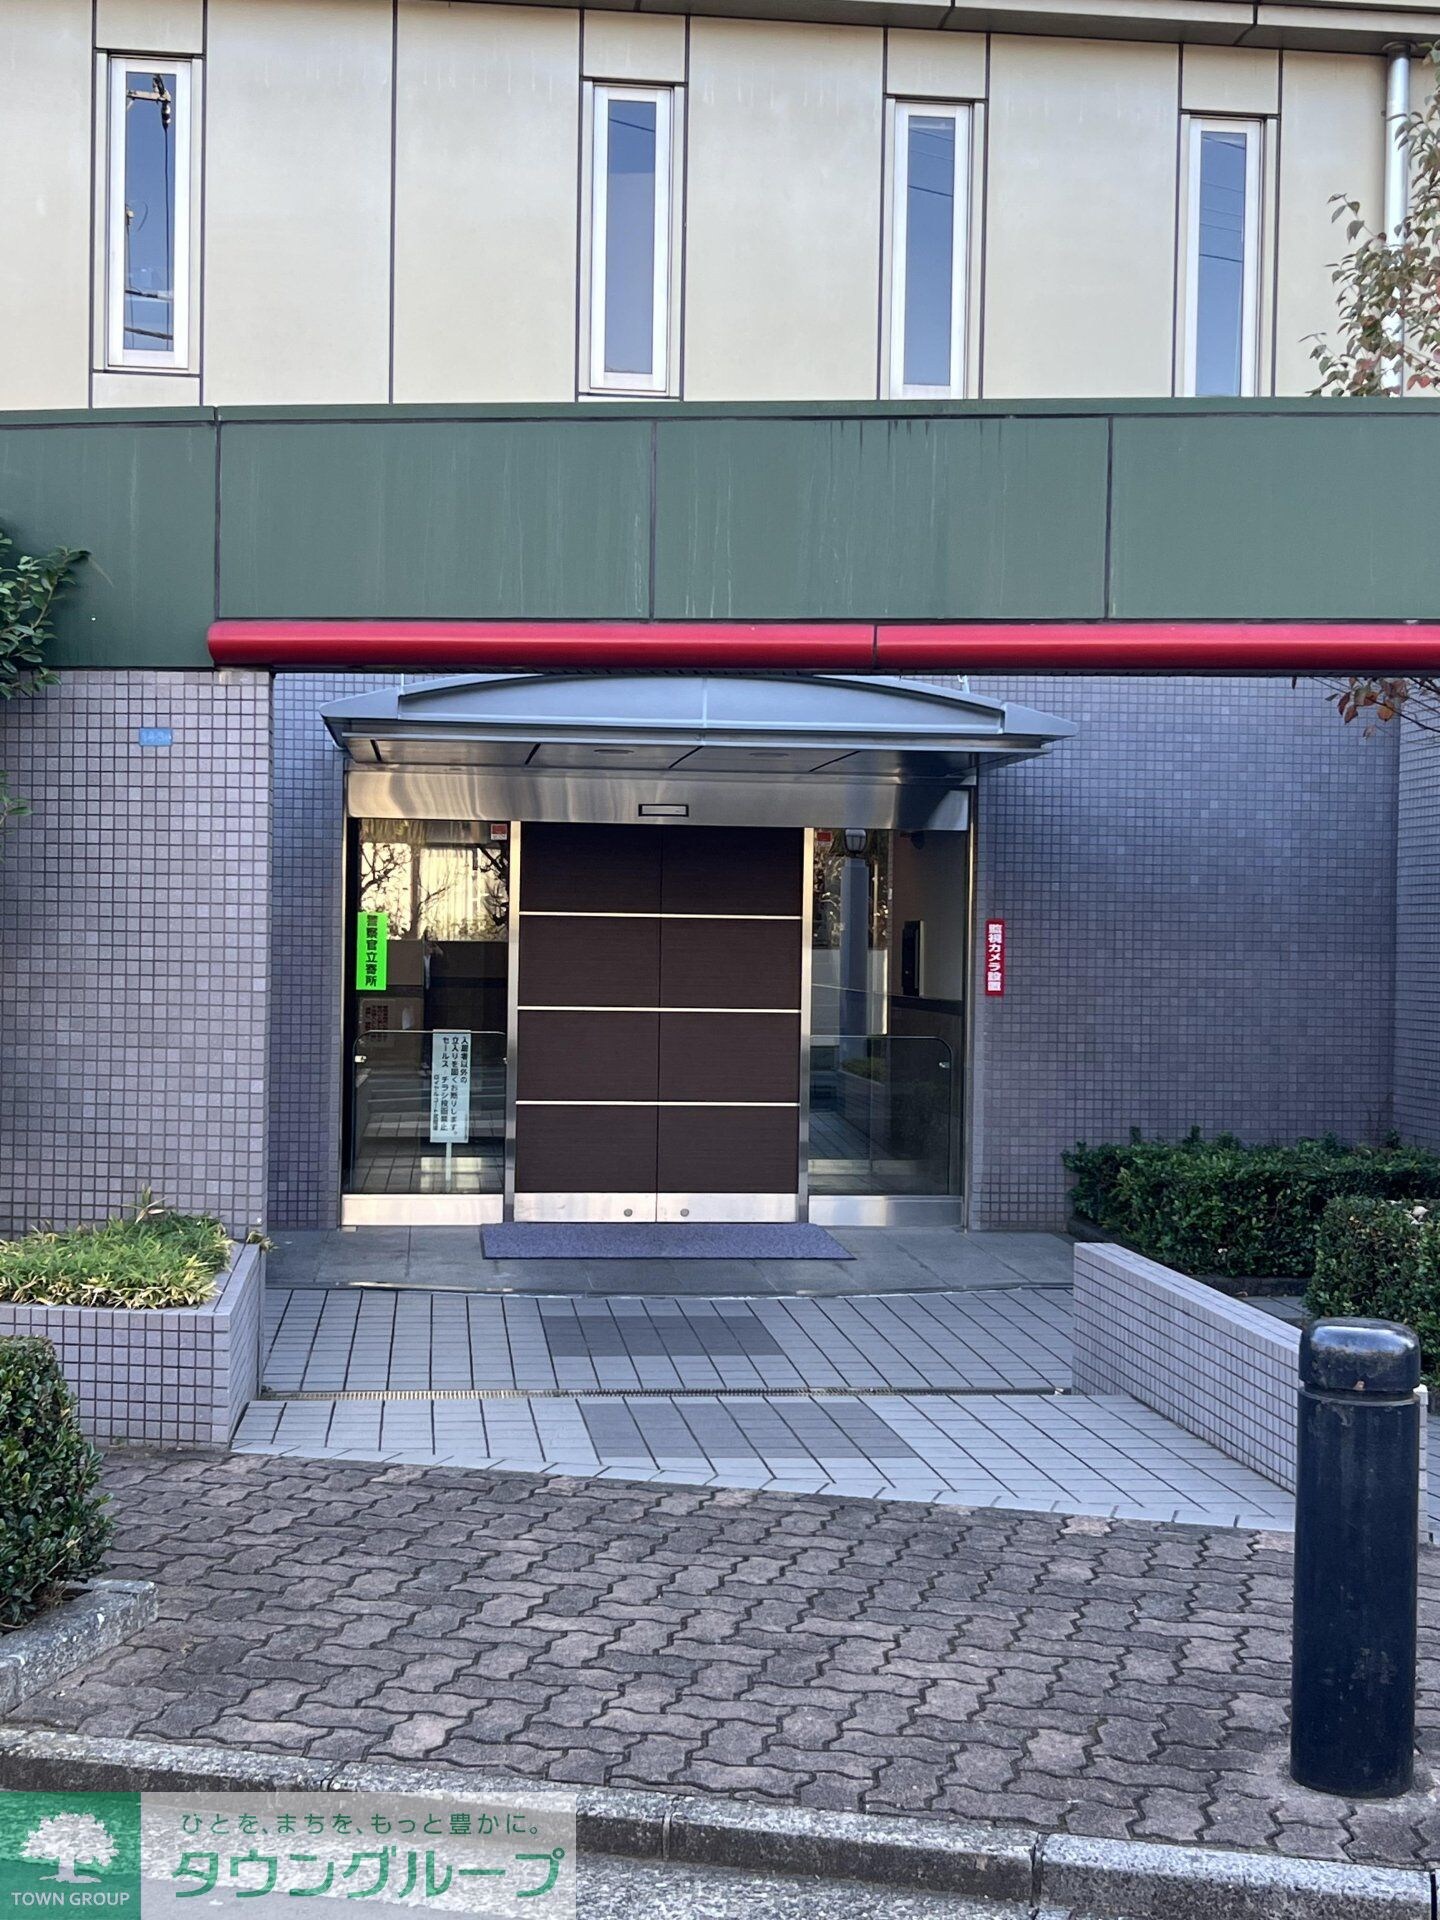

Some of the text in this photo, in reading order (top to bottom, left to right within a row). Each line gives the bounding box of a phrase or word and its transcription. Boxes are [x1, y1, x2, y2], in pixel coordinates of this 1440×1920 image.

[365, 914, 378, 988] 警察官立寄所
[988, 924, 1002, 991] 監視カメラ設置
